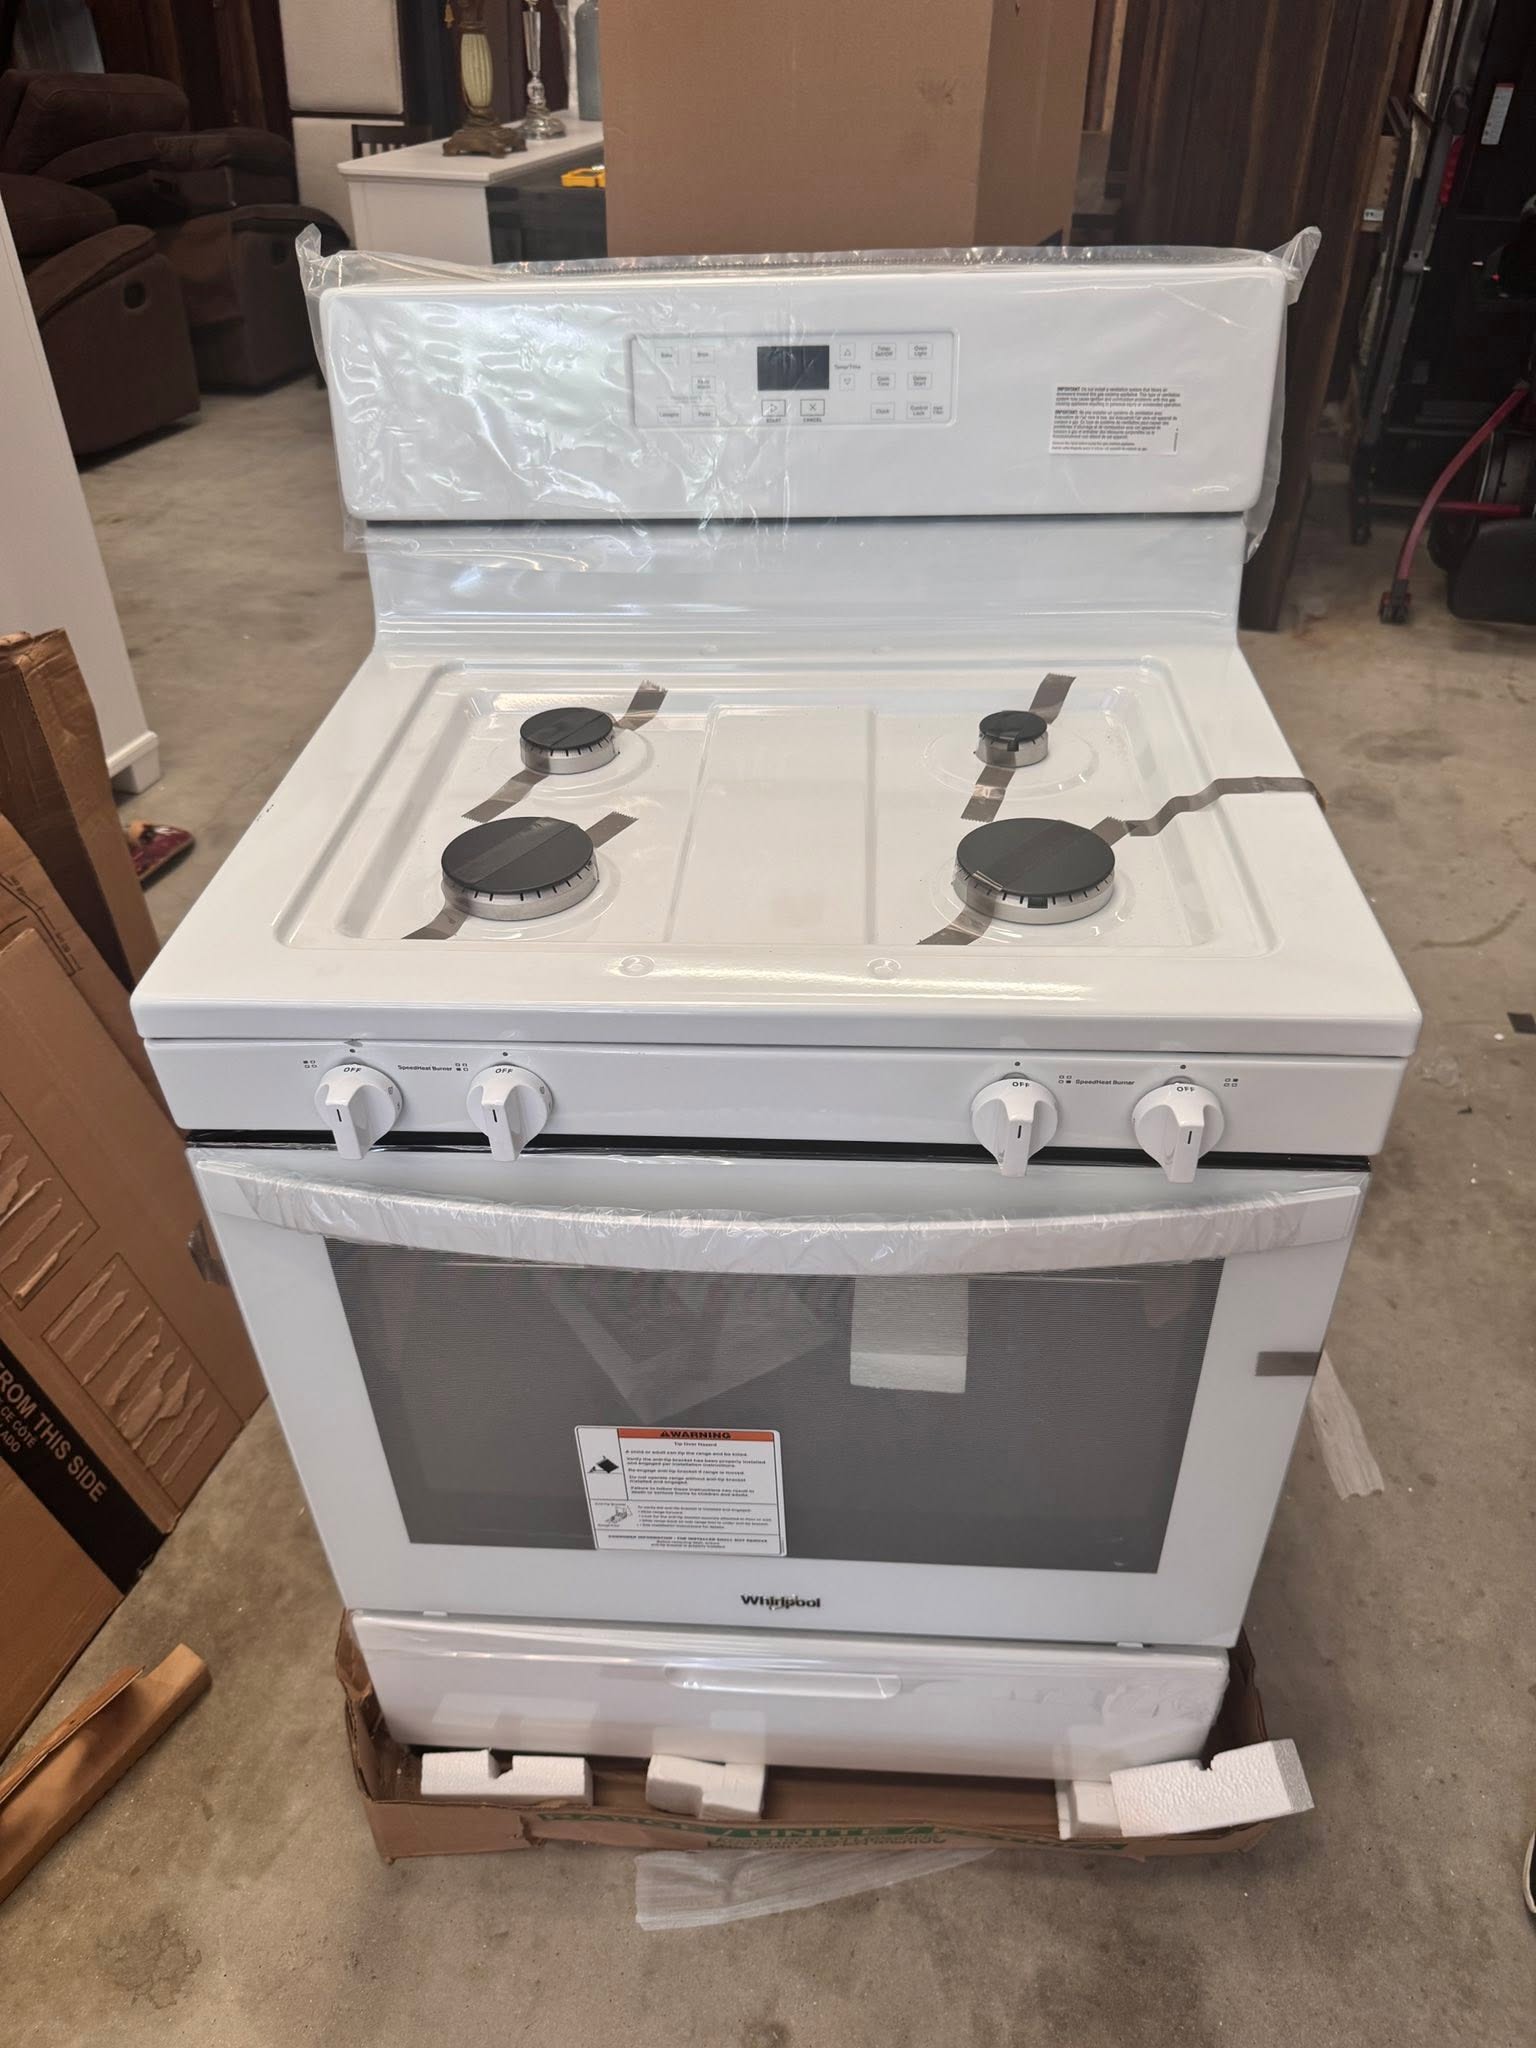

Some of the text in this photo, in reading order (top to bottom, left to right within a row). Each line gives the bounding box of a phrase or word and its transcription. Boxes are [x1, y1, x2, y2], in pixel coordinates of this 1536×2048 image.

[398, 1064, 431, 1072] SpeedHeat
[1075, 1079, 1111, 1087] SpeedHeat
[1, 1406, 16, 1423] CE
[0, 1360, 108, 1503] ROM THIS SIDE
[0, 1424, 21, 1453] ADO
[671, 1430, 732, 1440] WARNING
[740, 1595, 821, 1609] Whirlpool
